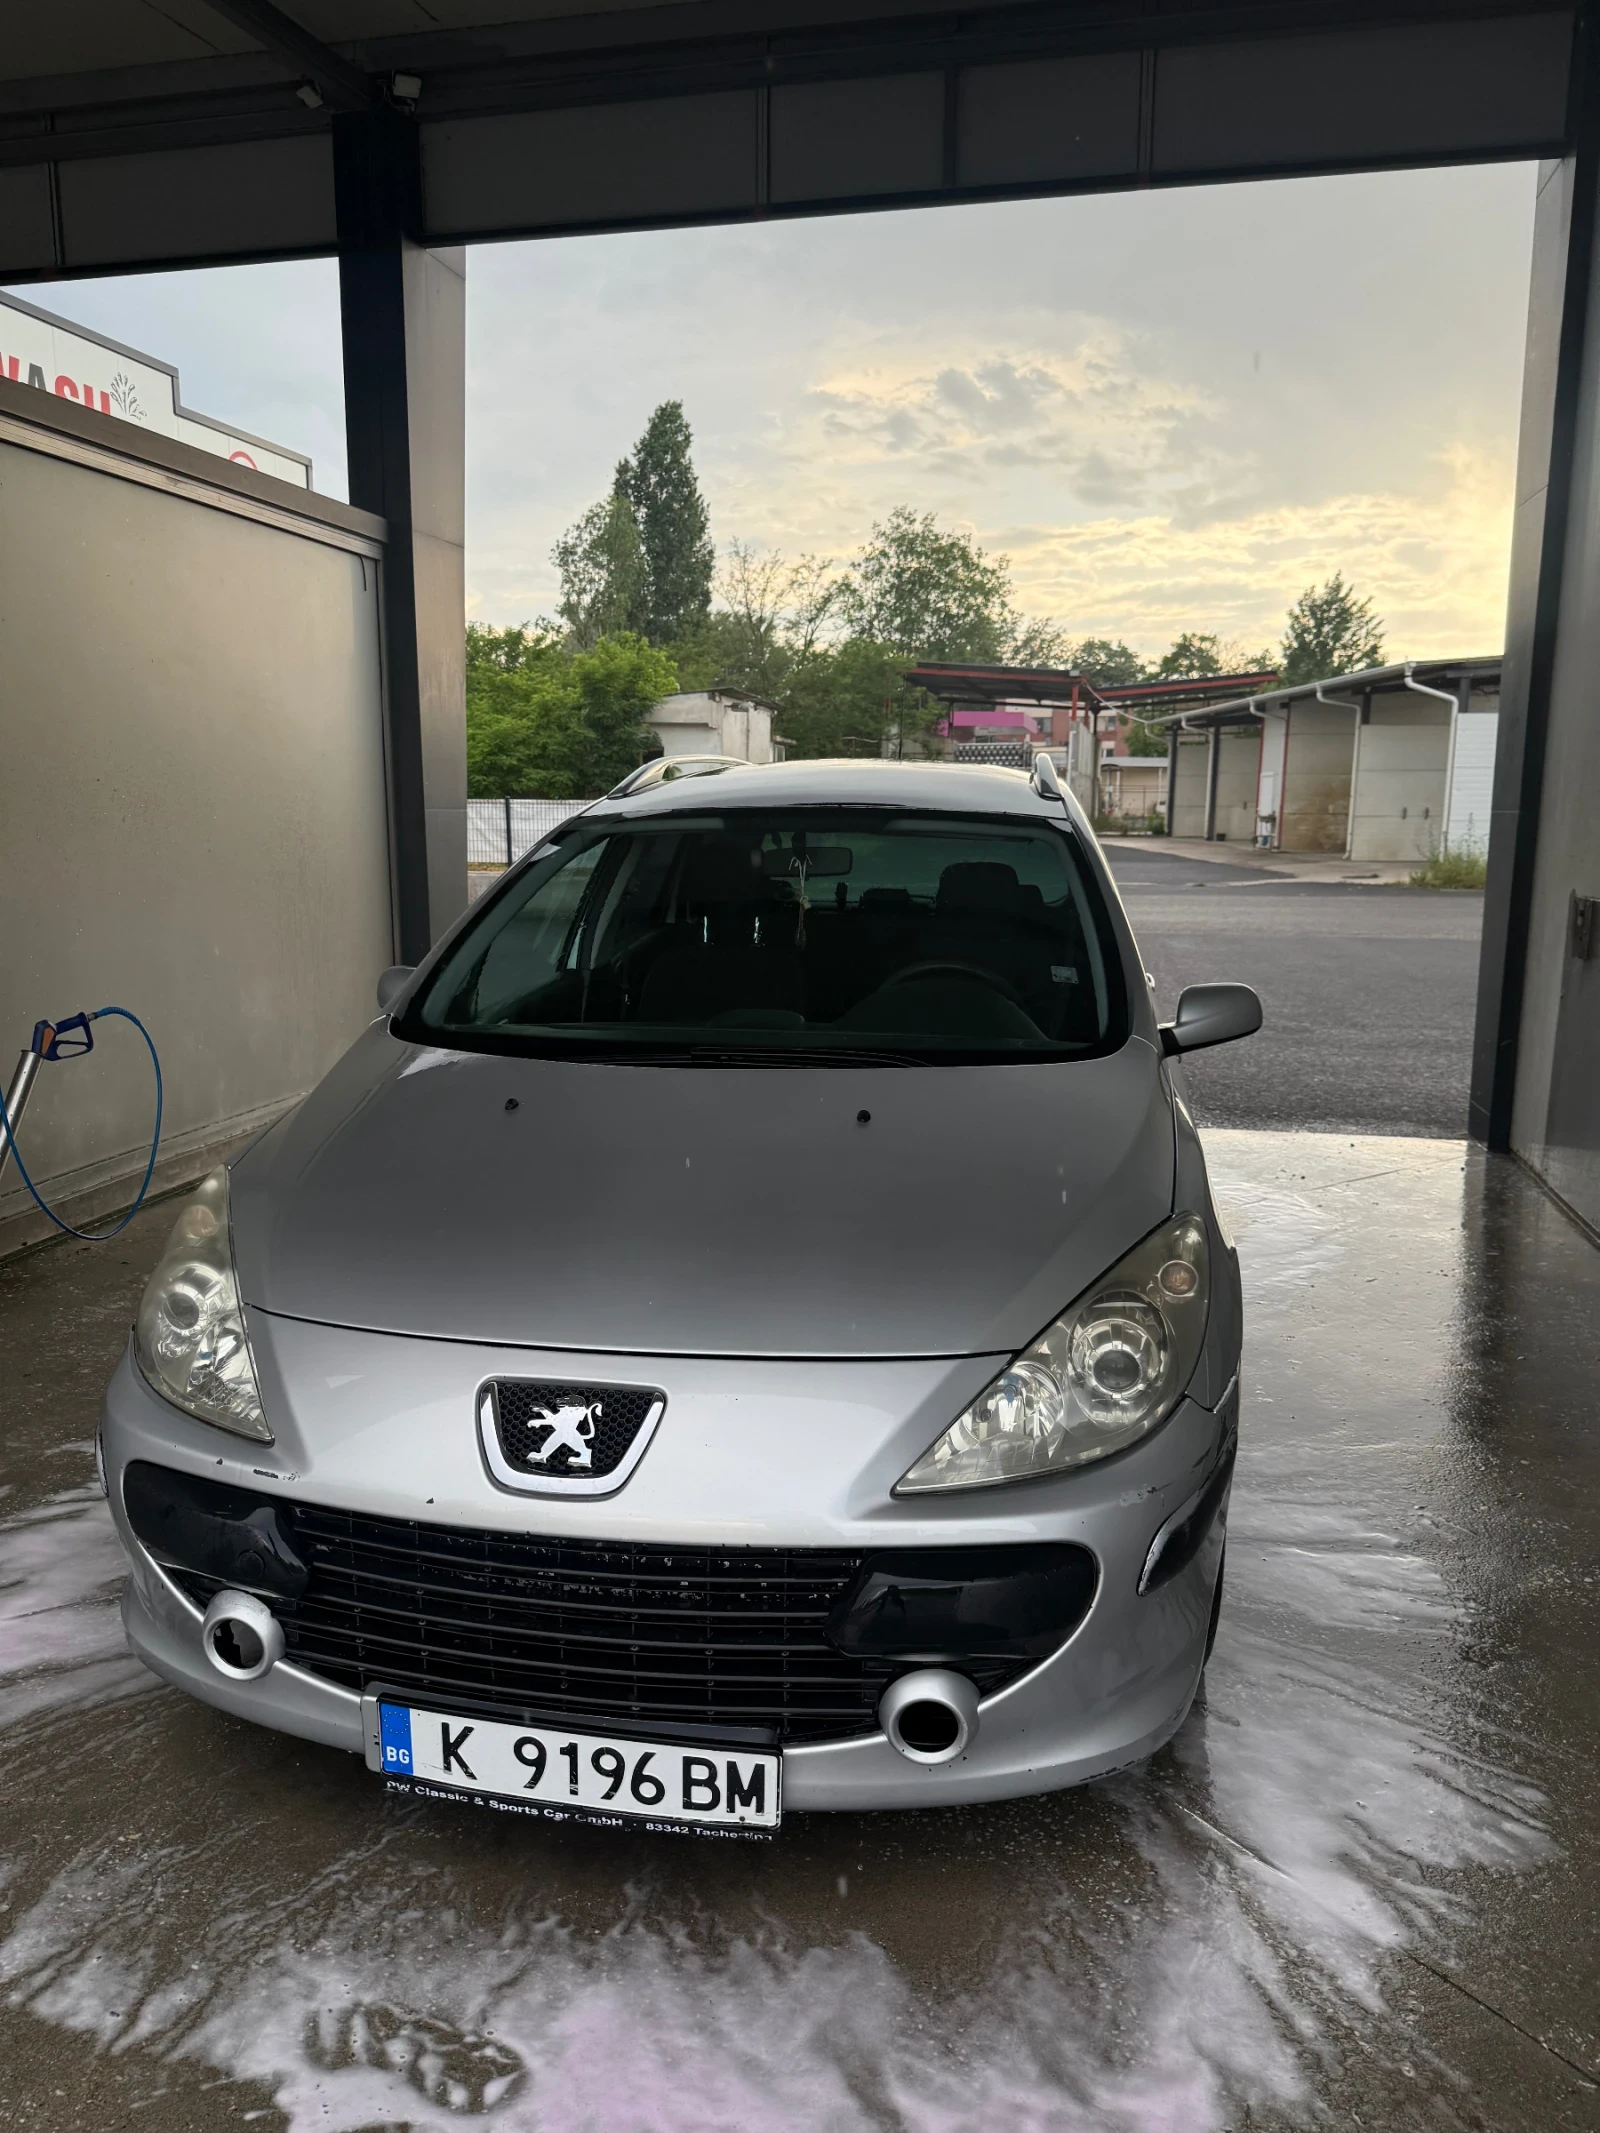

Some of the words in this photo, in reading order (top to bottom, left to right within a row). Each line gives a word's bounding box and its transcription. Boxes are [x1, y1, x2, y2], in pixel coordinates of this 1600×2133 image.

[0, 352, 110, 415] AS
[386, 1746, 410, 1765] BG
[440, 1721, 478, 1780] K
[513, 1736, 666, 1806] 9196
[682, 1755, 765, 1817] BM
[414, 1786, 469, 1802] Classic
[473, 1796, 485, 1806] &
[489, 1800, 539, 1816] Sports
[543, 1808, 571, 1820] Car
[574, 1813, 623, 1826] GmbH
[645, 1822, 690, 1834] 83342
